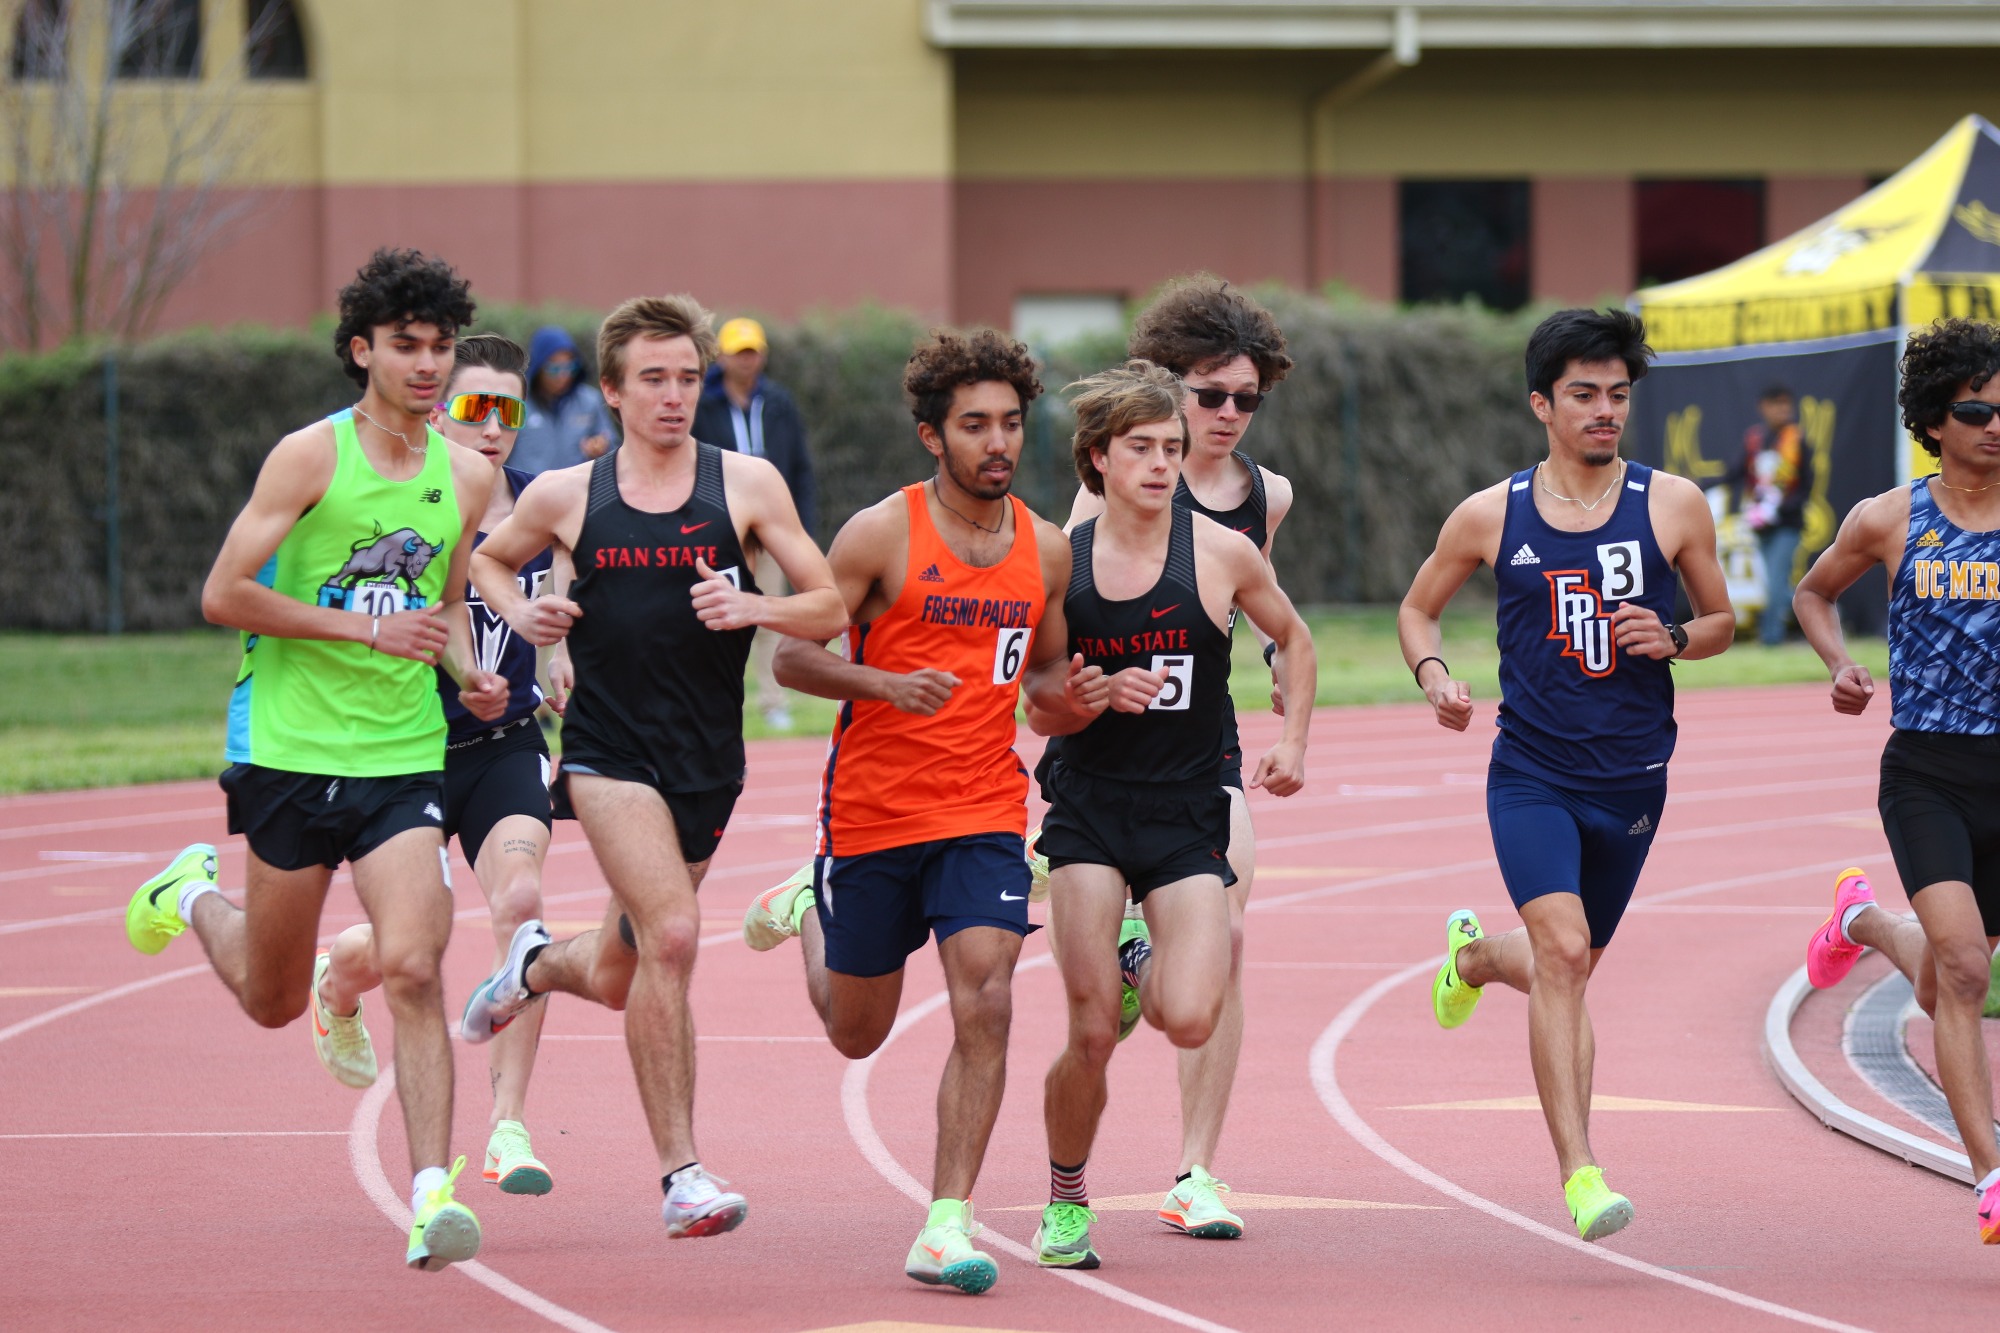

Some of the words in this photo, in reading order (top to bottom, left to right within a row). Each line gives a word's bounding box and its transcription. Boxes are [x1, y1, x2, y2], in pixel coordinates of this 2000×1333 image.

[595, 547, 649, 568] STAN
[655, 546, 717, 567] STATE
[1511, 555, 1540, 566] adidas
[1607, 546, 1634, 596] 3
[918, 575, 944, 583] adidas
[1914, 560, 1945, 599] UC
[1949, 560, 2000, 600] MER
[921, 595, 979, 626] FRESNO
[979, 599, 1031, 629] PACIFIC
[1549, 572, 1611, 674] FPU
[1002, 631, 1023, 681] 6
[1078, 637, 1124, 656] STAN
[1130, 629, 1188, 653] STATE
[1158, 658, 1184, 707] 5
[1628, 825, 1652, 835] adidas
